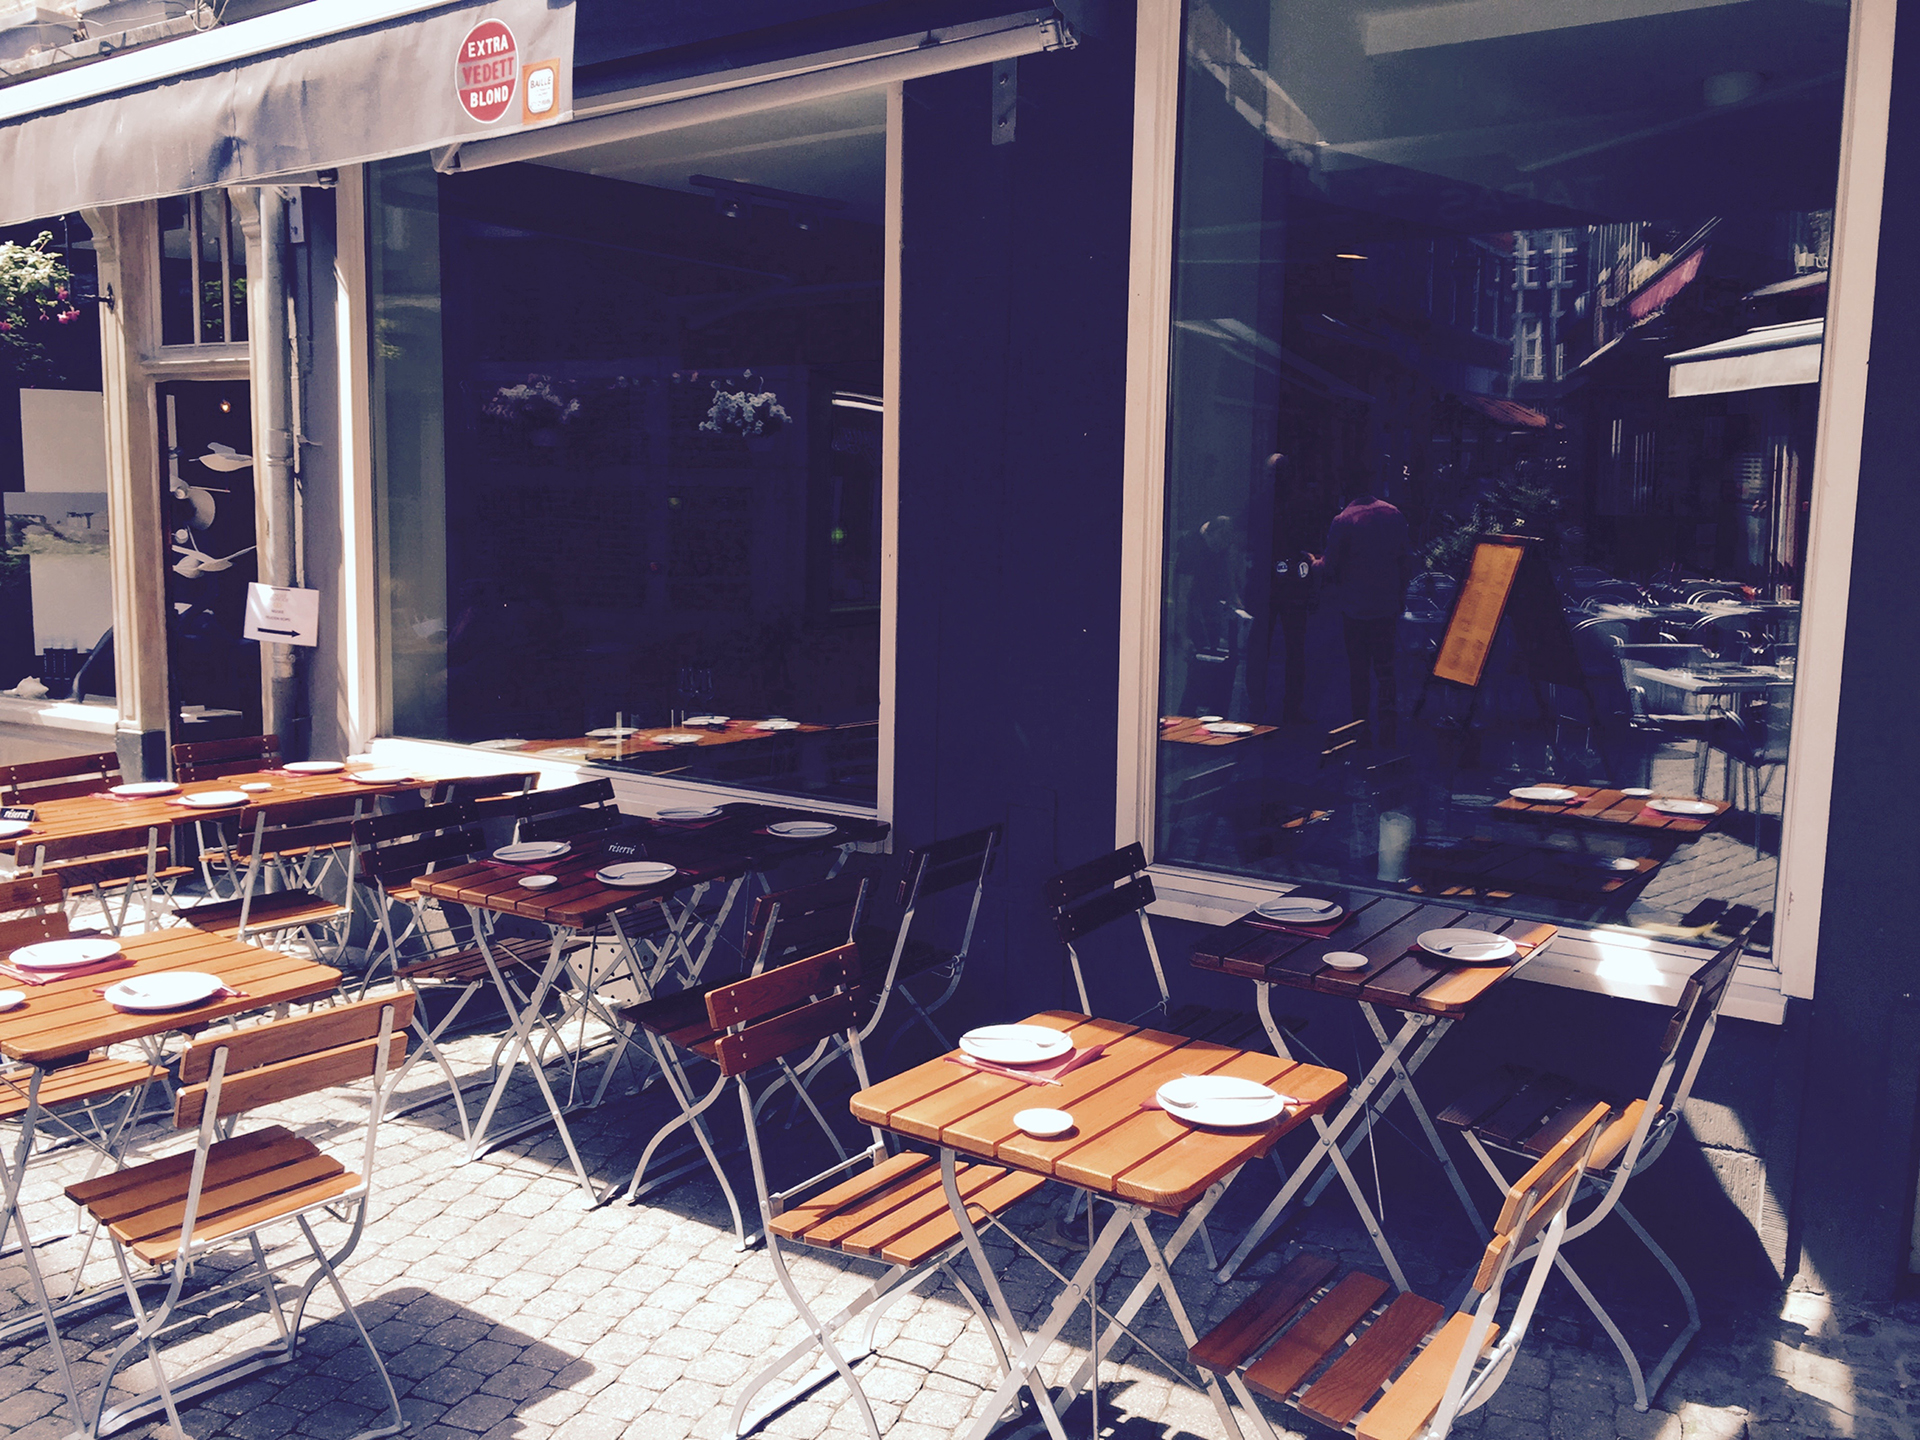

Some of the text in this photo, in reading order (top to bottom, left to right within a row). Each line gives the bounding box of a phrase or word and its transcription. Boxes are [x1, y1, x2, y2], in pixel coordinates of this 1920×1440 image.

[468, 34, 509, 58] EXTRA
[462, 57, 514, 86] VEDETT
[470, 85, 509, 108] BLOND
